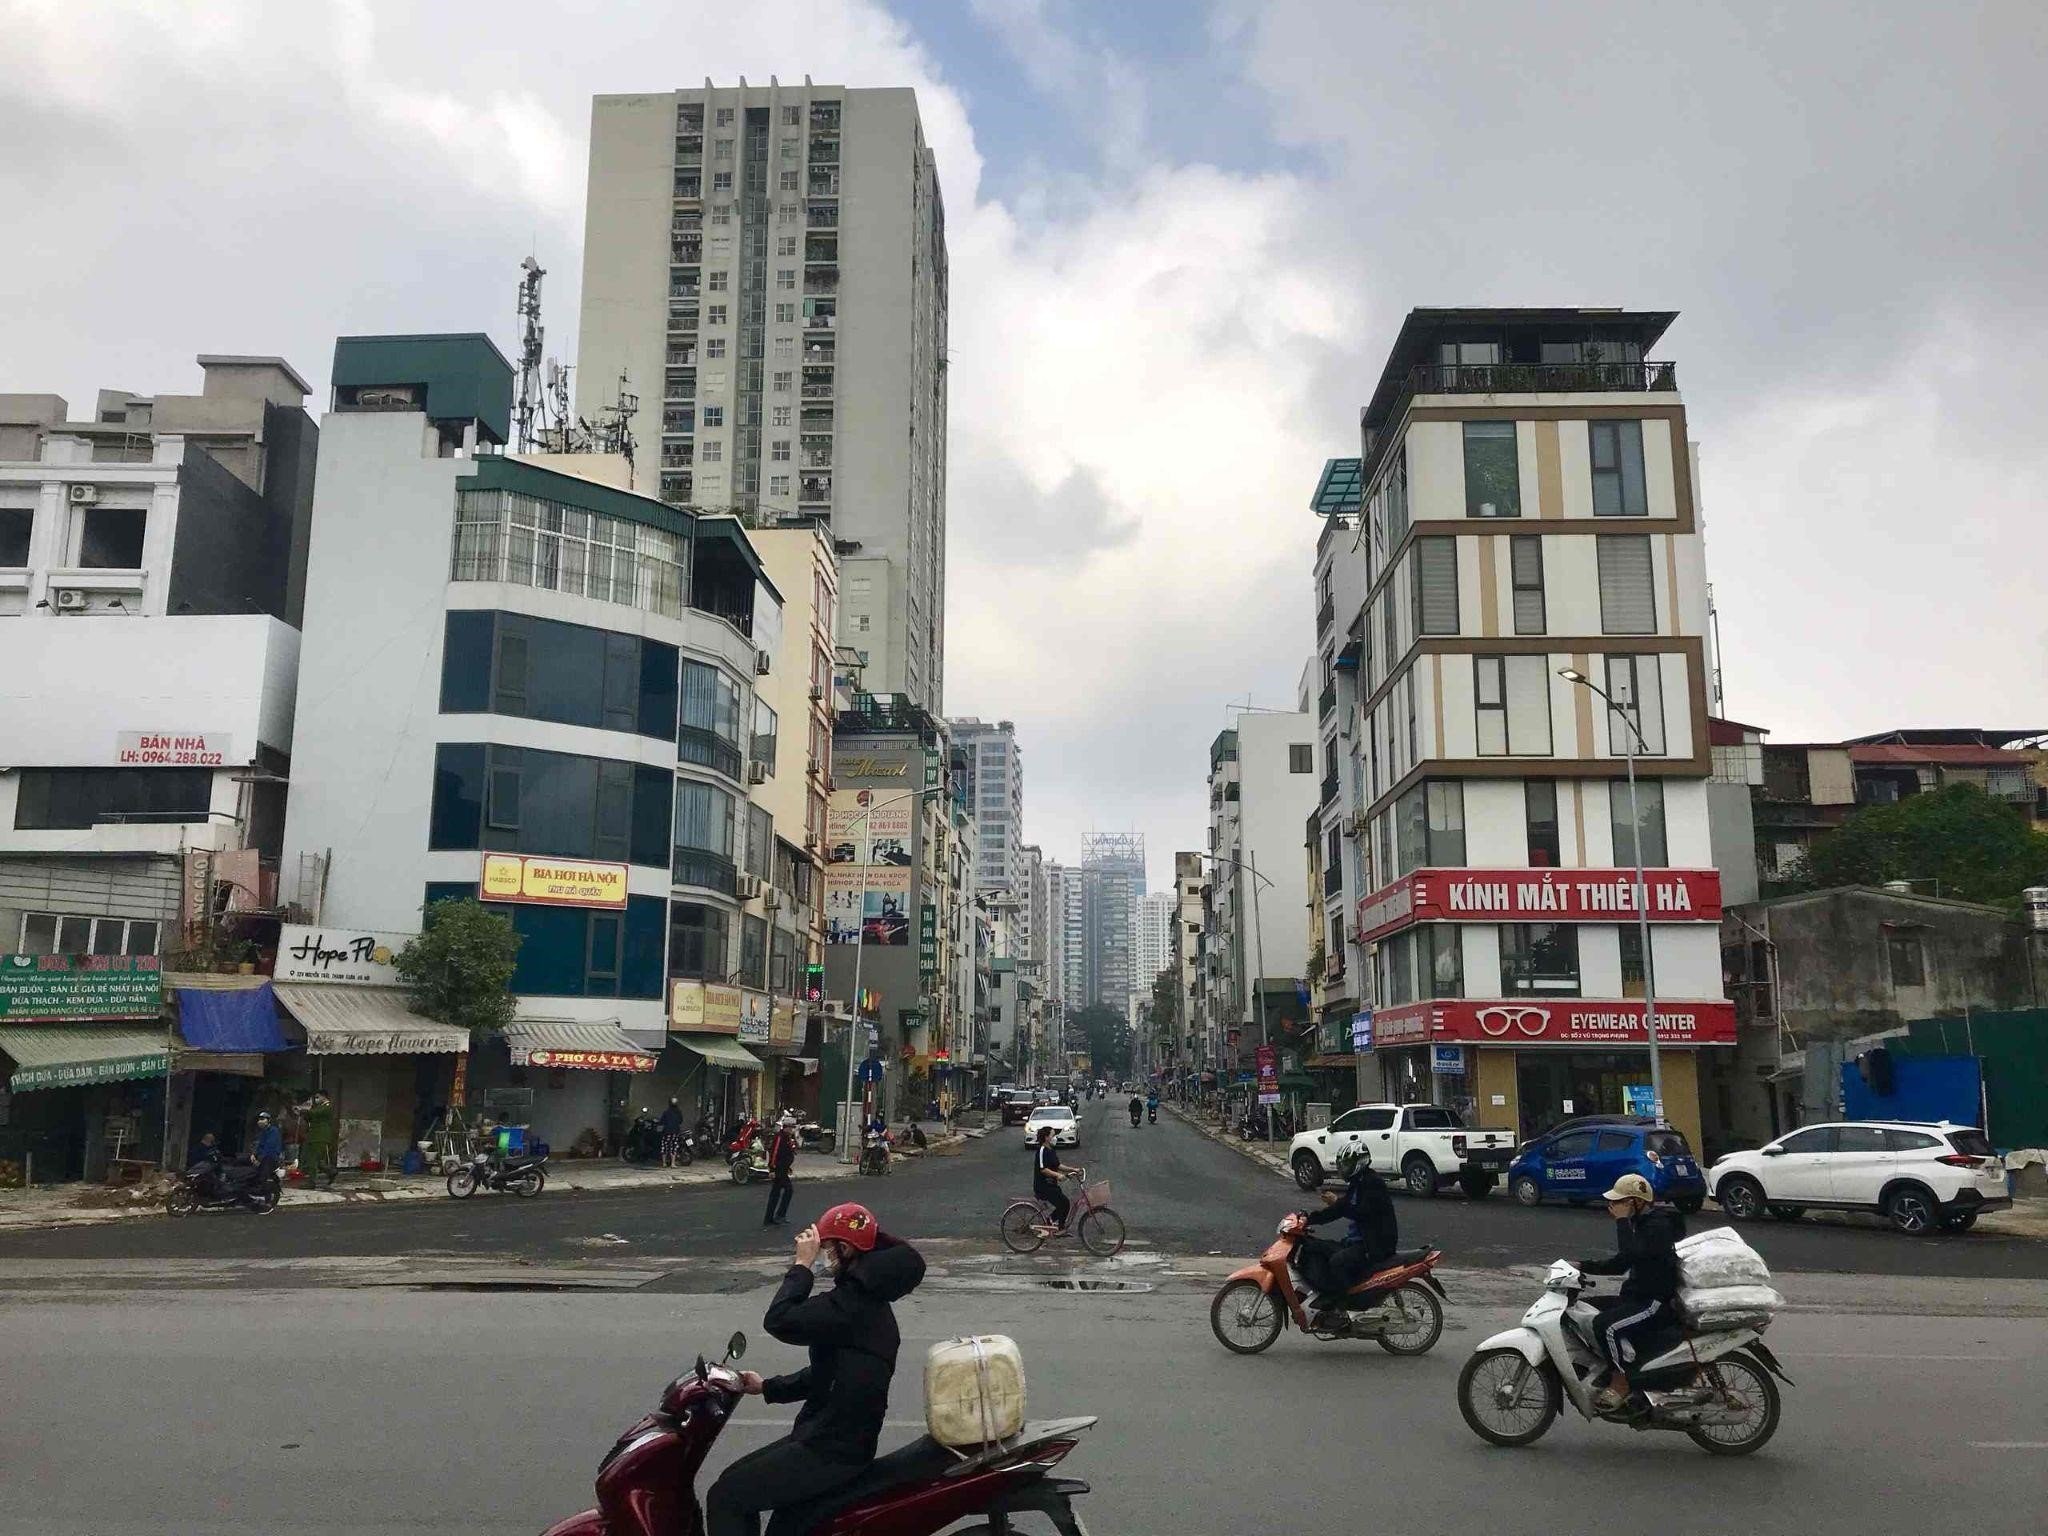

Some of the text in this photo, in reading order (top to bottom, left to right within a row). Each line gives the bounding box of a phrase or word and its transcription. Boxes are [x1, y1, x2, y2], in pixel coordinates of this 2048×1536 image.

[141, 734, 206, 750] BÁN NHÀ
[120, 751, 222, 765] LH: 0964.288.022
[533, 868, 552, 879] BIA
[579, 870, 594, 882] HÀ
[597, 872, 618, 886] NỘI
[1449, 872, 1692, 911] KÍNH MẮT THIÊN HÀ
[290, 934, 348, 969] Hope
[20, 984, 43, 993] BUÔN
[51, 984, 67, 993] BÁN
[1571, 1013, 1697, 1030] EYEWEAR CENTER
[344, 1033, 383, 1051] Hope
[388, 1032, 439, 1051] flowers
[554, 1052, 585, 1062] PHỞ
[587, 1053, 608, 1063] GÀ
[610, 1056, 631, 1065] TA
